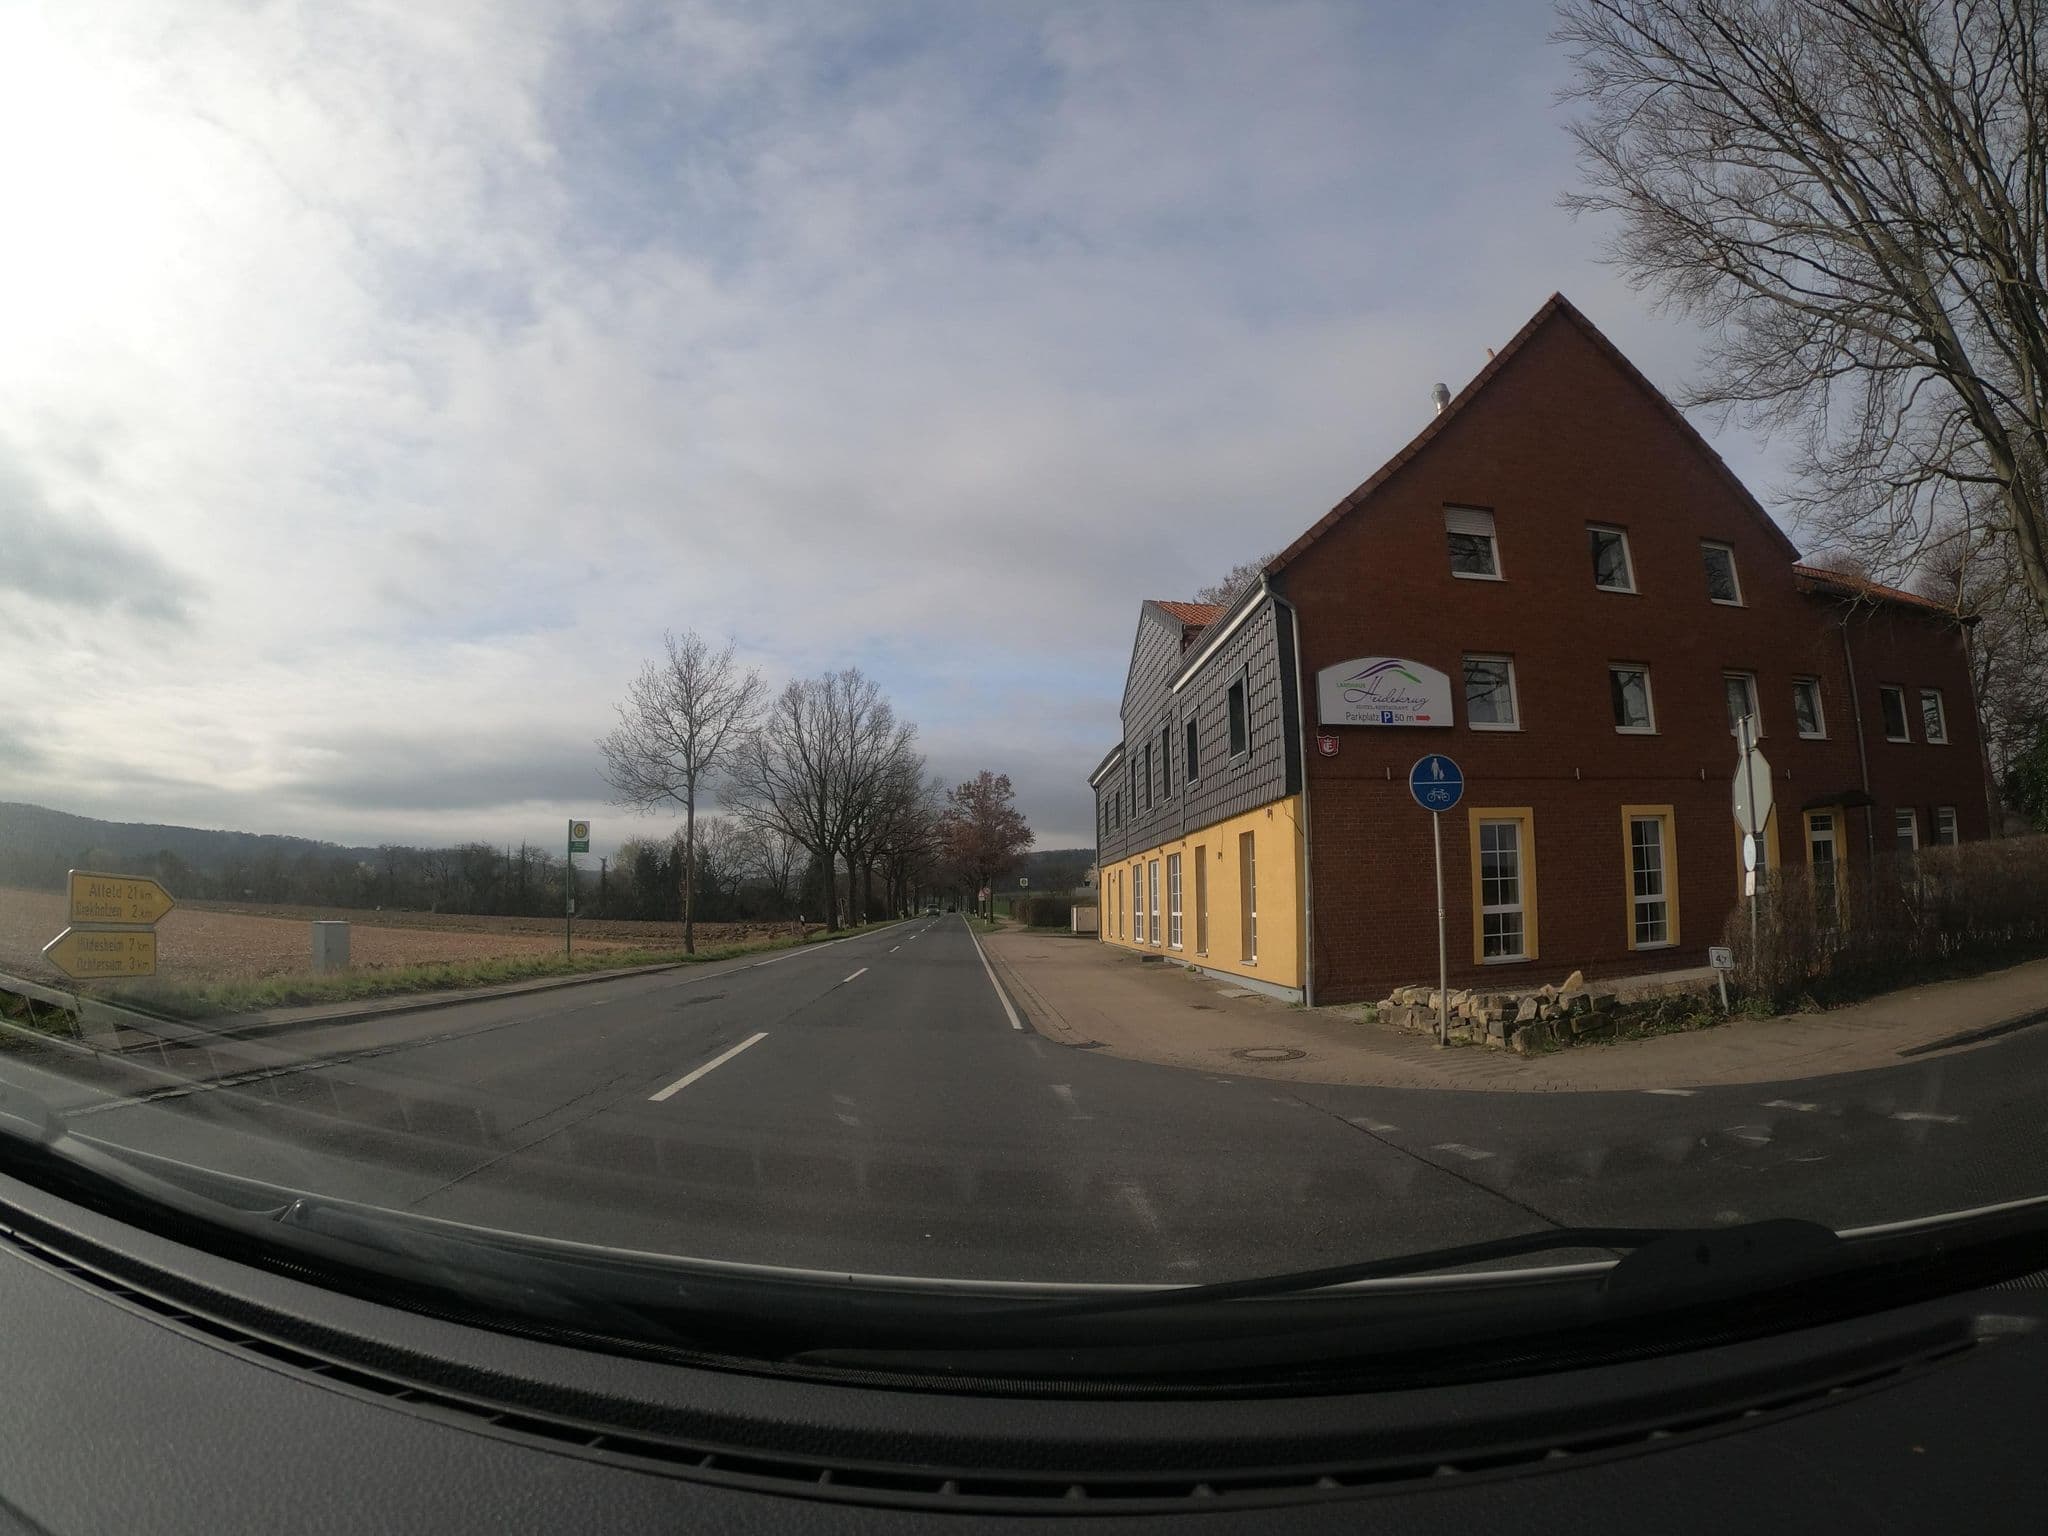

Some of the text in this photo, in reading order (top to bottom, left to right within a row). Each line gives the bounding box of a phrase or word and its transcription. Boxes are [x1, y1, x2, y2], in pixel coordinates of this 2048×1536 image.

[1344, 676, 1430, 711] Heidekrug
[1345, 711, 1381, 722] Parkplatz
[89, 882, 122, 899] Alfeld
[131, 904, 138, 919] 2
[128, 937, 136, 952] 7
[128, 956, 136, 970] 3
